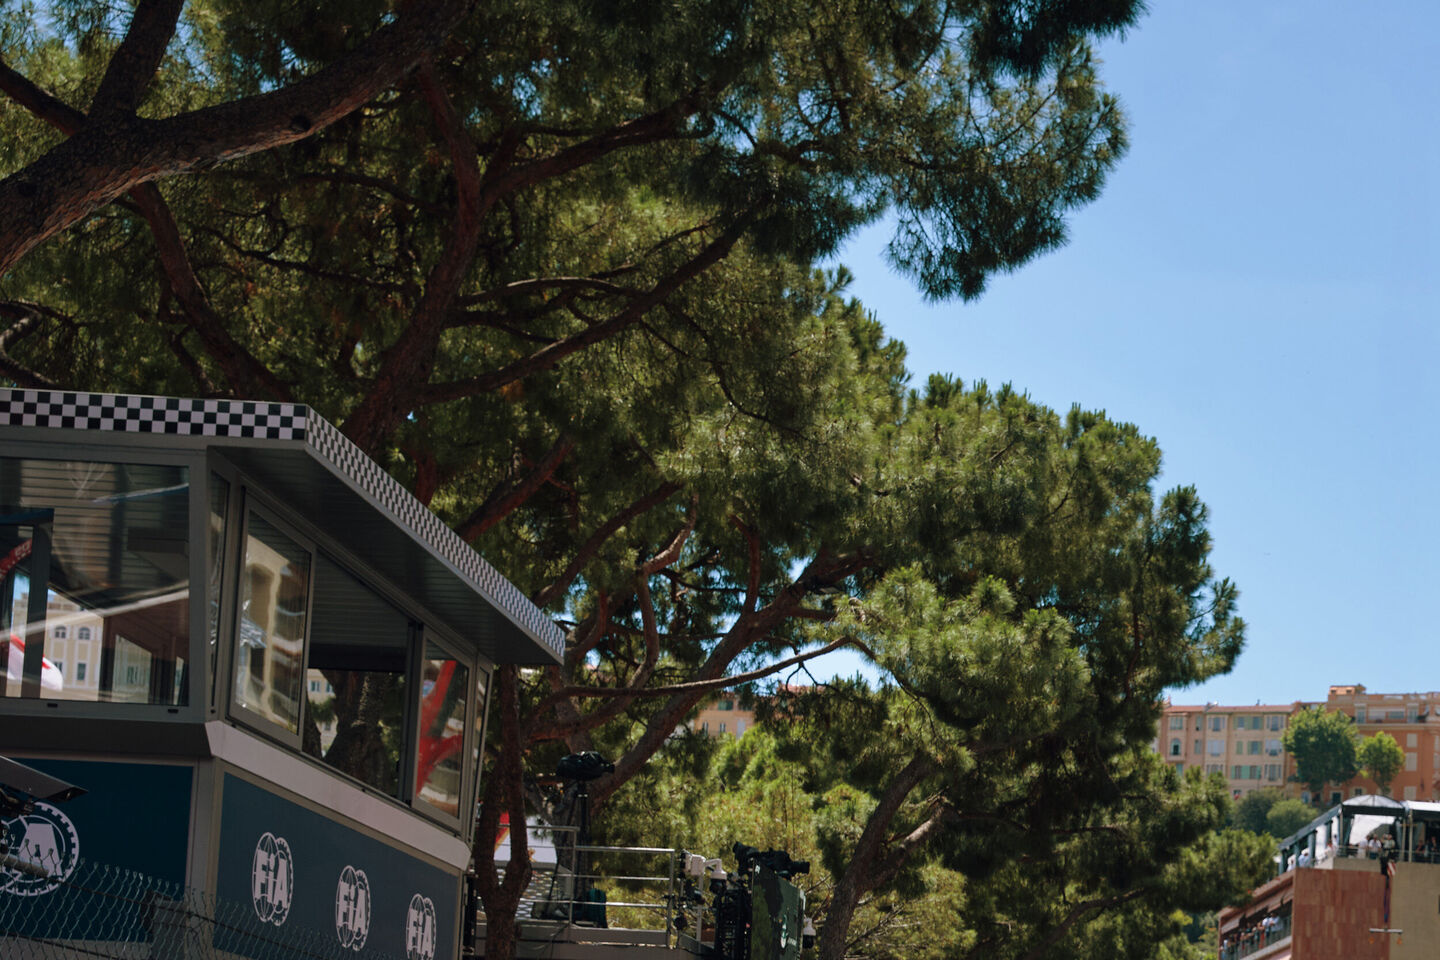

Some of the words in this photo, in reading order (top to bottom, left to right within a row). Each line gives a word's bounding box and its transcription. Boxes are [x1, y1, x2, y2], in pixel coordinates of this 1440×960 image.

[254, 849, 289, 909] FIA
[336, 881, 367, 935] FIA
[407, 908, 433, 957] FIA
